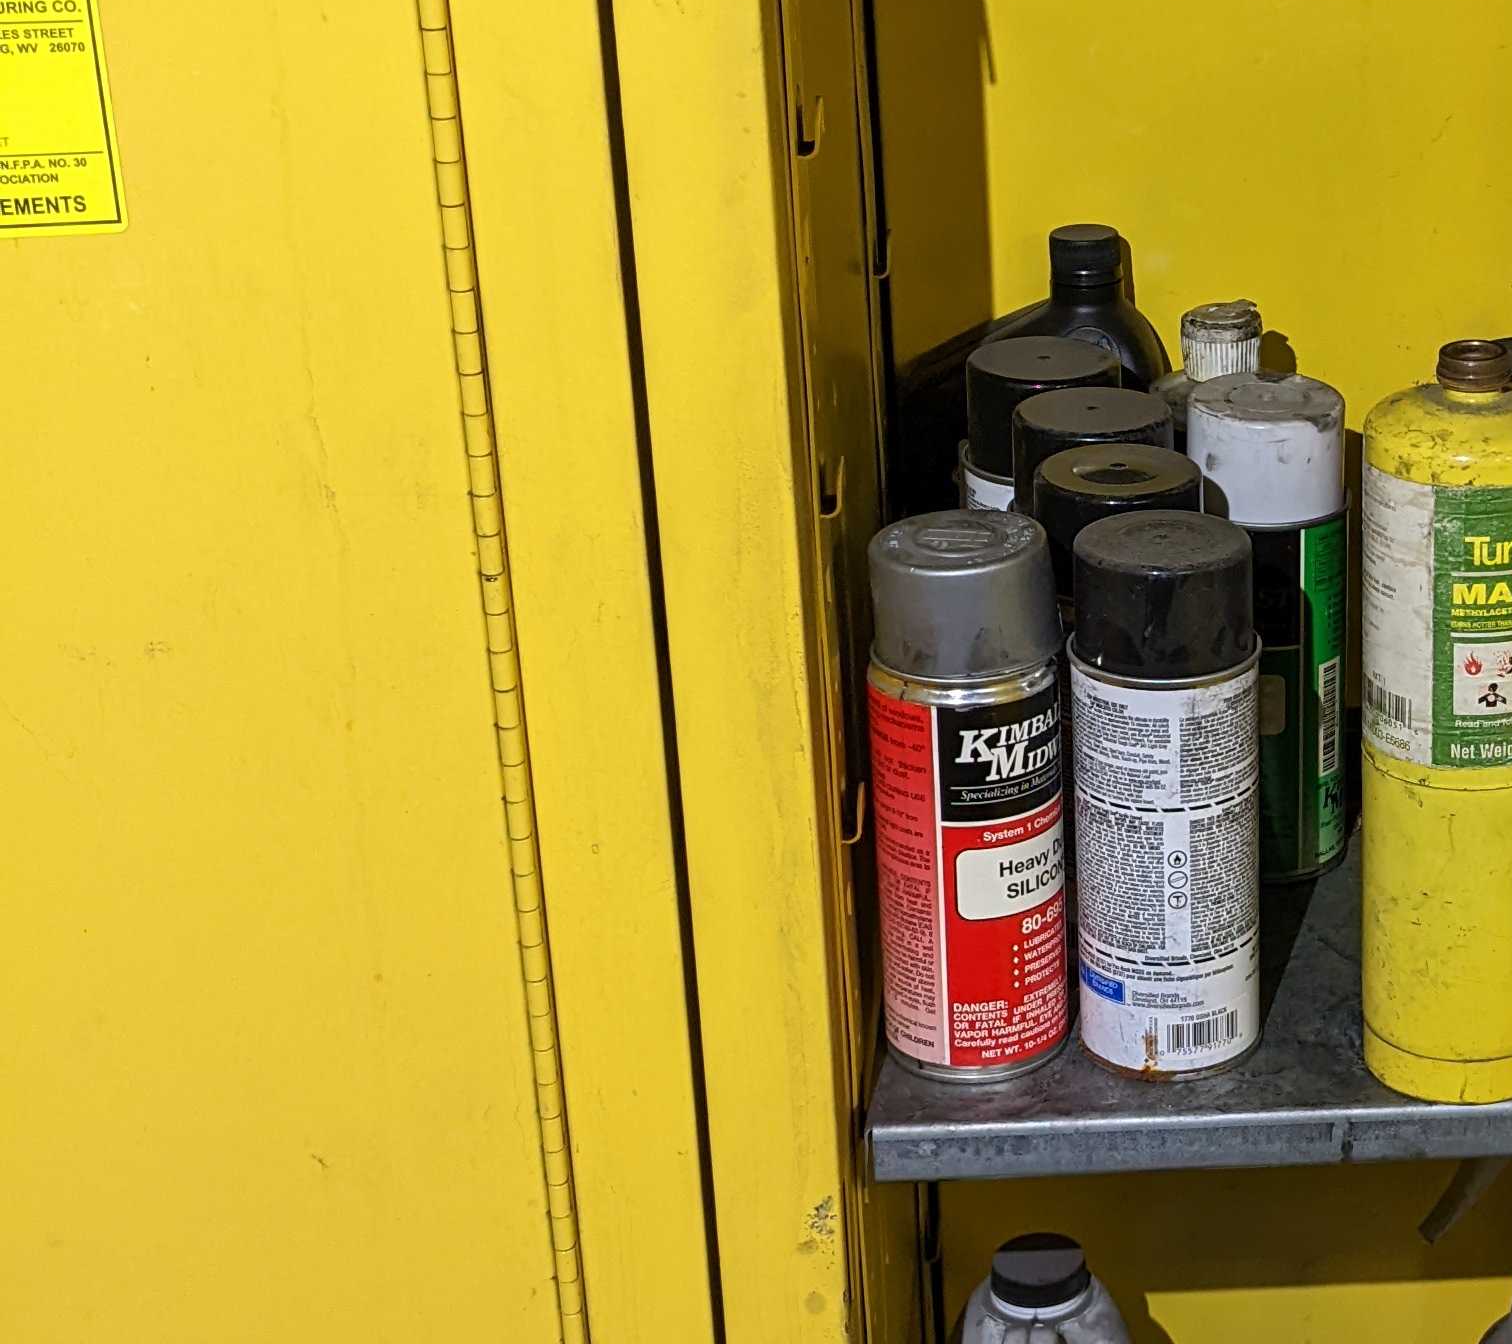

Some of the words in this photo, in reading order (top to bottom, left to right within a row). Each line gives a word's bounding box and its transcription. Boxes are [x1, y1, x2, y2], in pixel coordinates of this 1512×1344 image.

[52, 0, 82, 13] CO.
[23, 28, 74, 39] STREET
[17, 44, 38, 53] WV
[49, 42, 85, 52] 26070
[49, 159, 70, 168] NO.
[74, 158, 87, 167] 30
[1450, 743, 1474, 759] Net
[983, 826, 1024, 842] System
[1000, 853, 1049, 878] Heavy
[953, 1000, 1008, 1012] DANGER:
[982, 1048, 1003, 1058] NET
[1005, 1044, 1022, 1055] WT.
